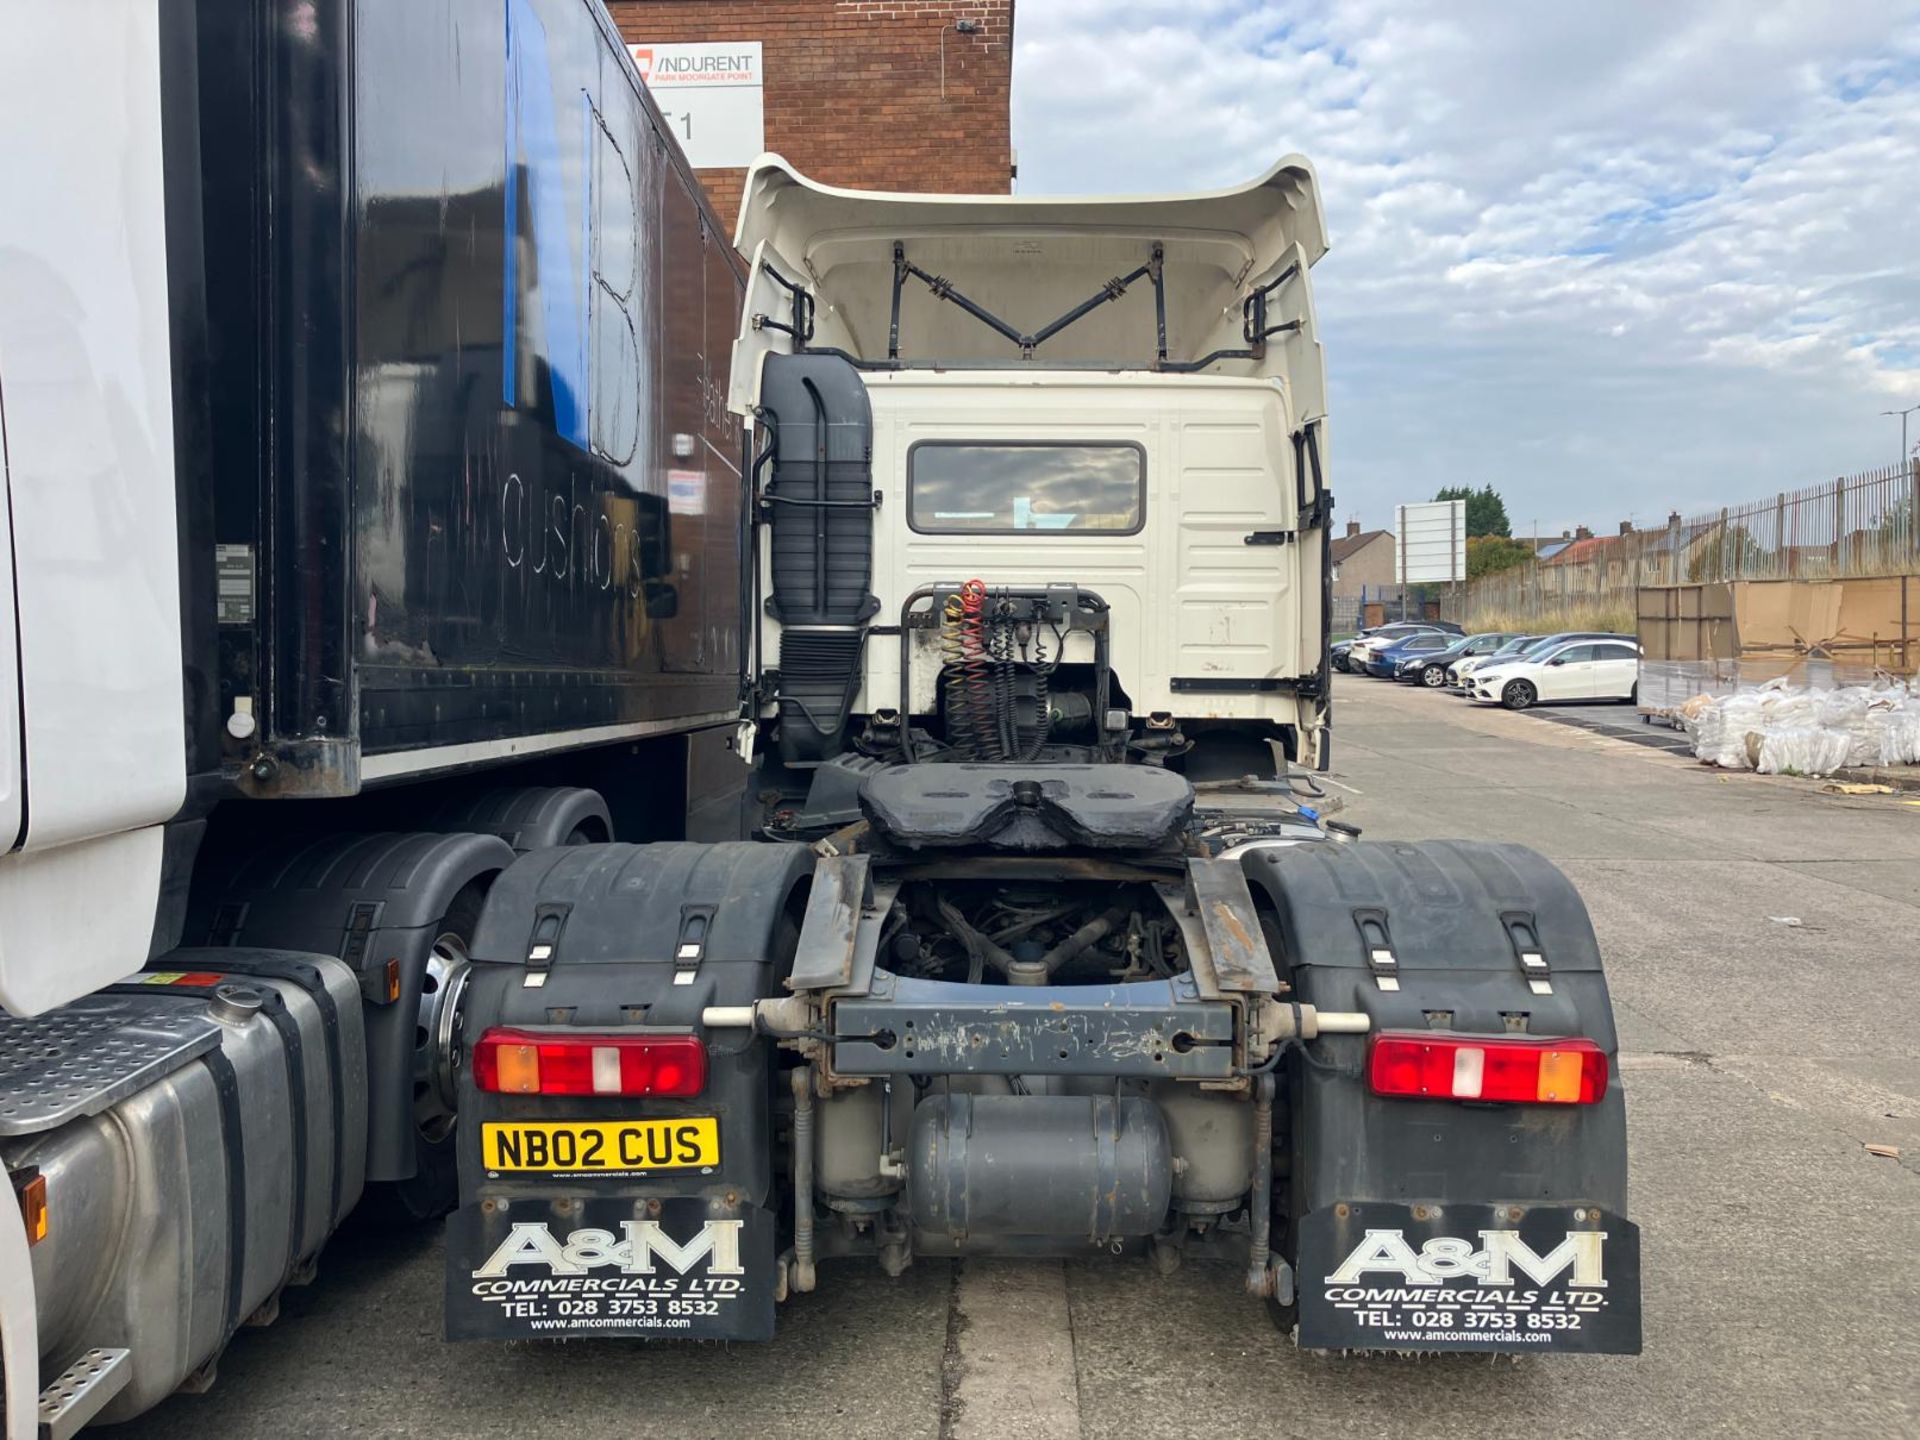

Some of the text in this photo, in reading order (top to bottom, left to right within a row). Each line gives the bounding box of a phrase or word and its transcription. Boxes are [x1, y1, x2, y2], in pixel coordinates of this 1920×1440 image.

[728, 72, 752, 80] POINT
[680, 112, 691, 140] 1
[496, 1126, 702, 1167] NB02 CUS
[472, 1220, 744, 1278] A&M
[1324, 1229, 1608, 1287] A&M
[472, 1278, 745, 1295] COMMERCIALS LTD.
[1324, 1288, 1608, 1305] COMMERCIALS LTD.
[501, 1300, 719, 1317] TEL: 028 3753 8532
[531, 1315, 690, 1329] www.amcommercials.com
[1354, 1311, 1581, 1329] TEL: 028 3753 8532
[1384, 1329, 1551, 1342] www.amcommercials.com
